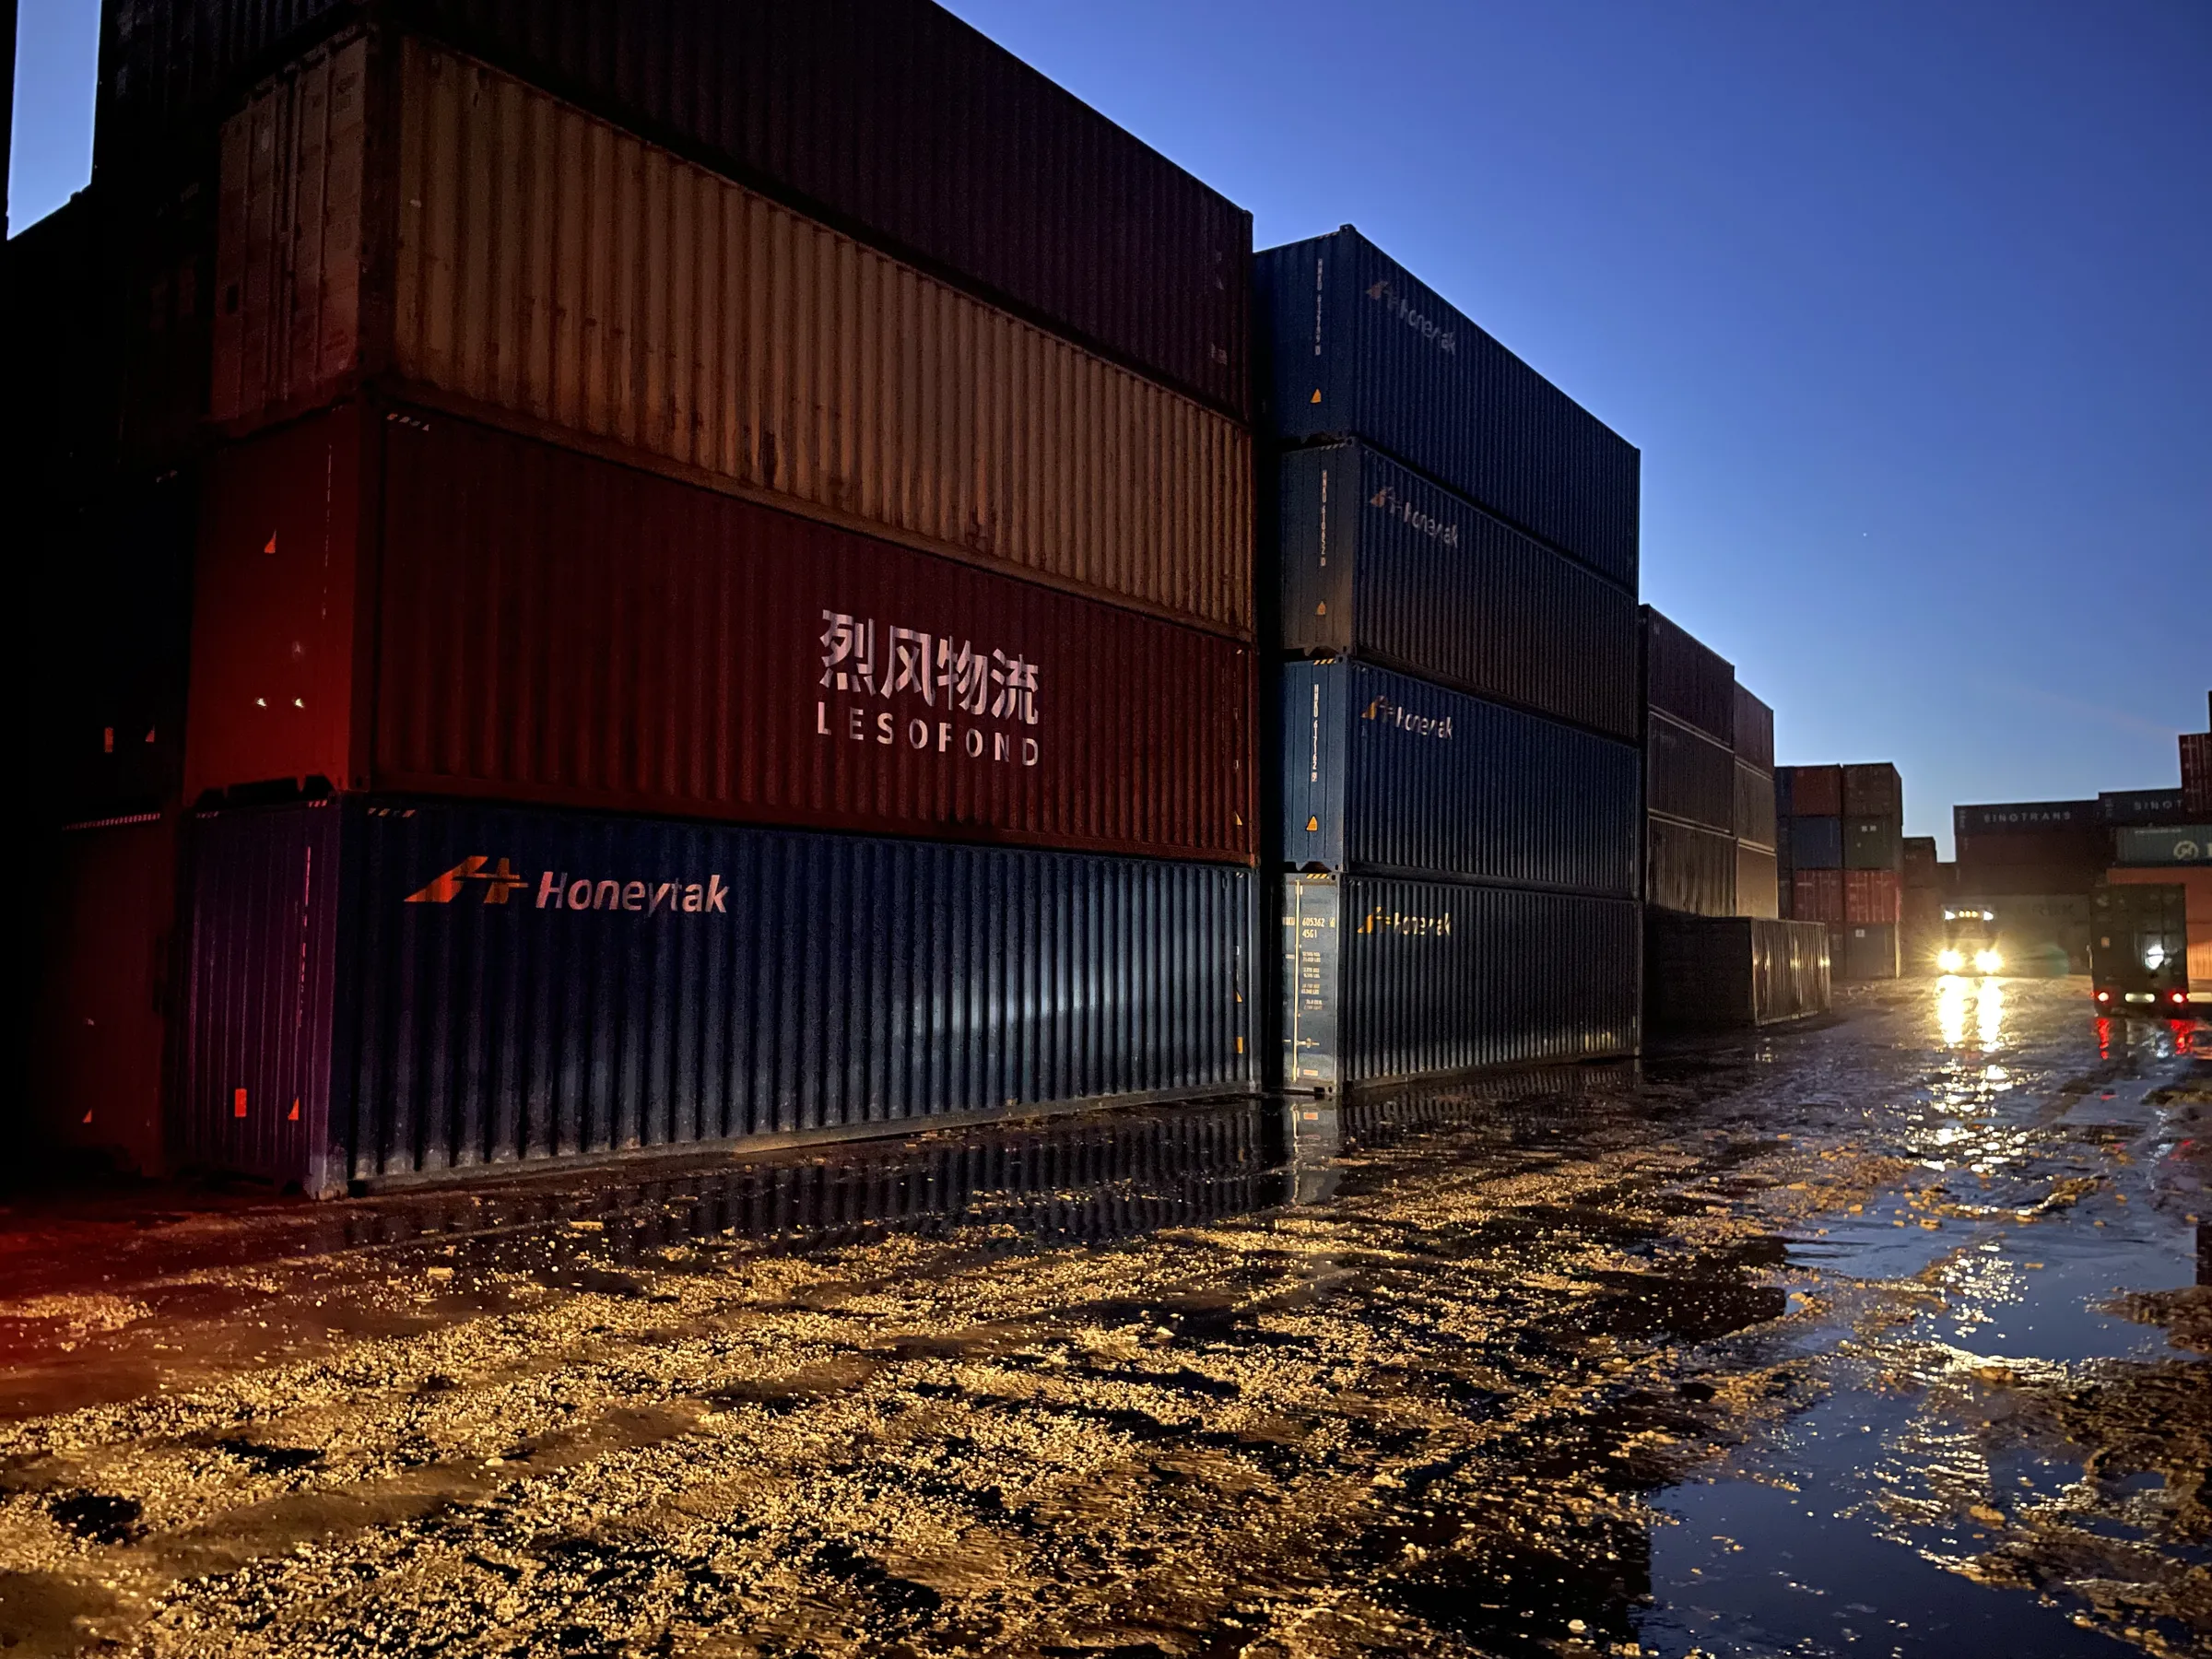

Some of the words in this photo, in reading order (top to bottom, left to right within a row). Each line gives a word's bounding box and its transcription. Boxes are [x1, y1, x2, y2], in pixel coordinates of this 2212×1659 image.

[819, 609, 1039, 724] 烈风物流
[818, 701, 1040, 766] LESOFOND
[1983, 811, 2071, 823] SINOTRANS
[535, 871, 729, 916] Honeytak
